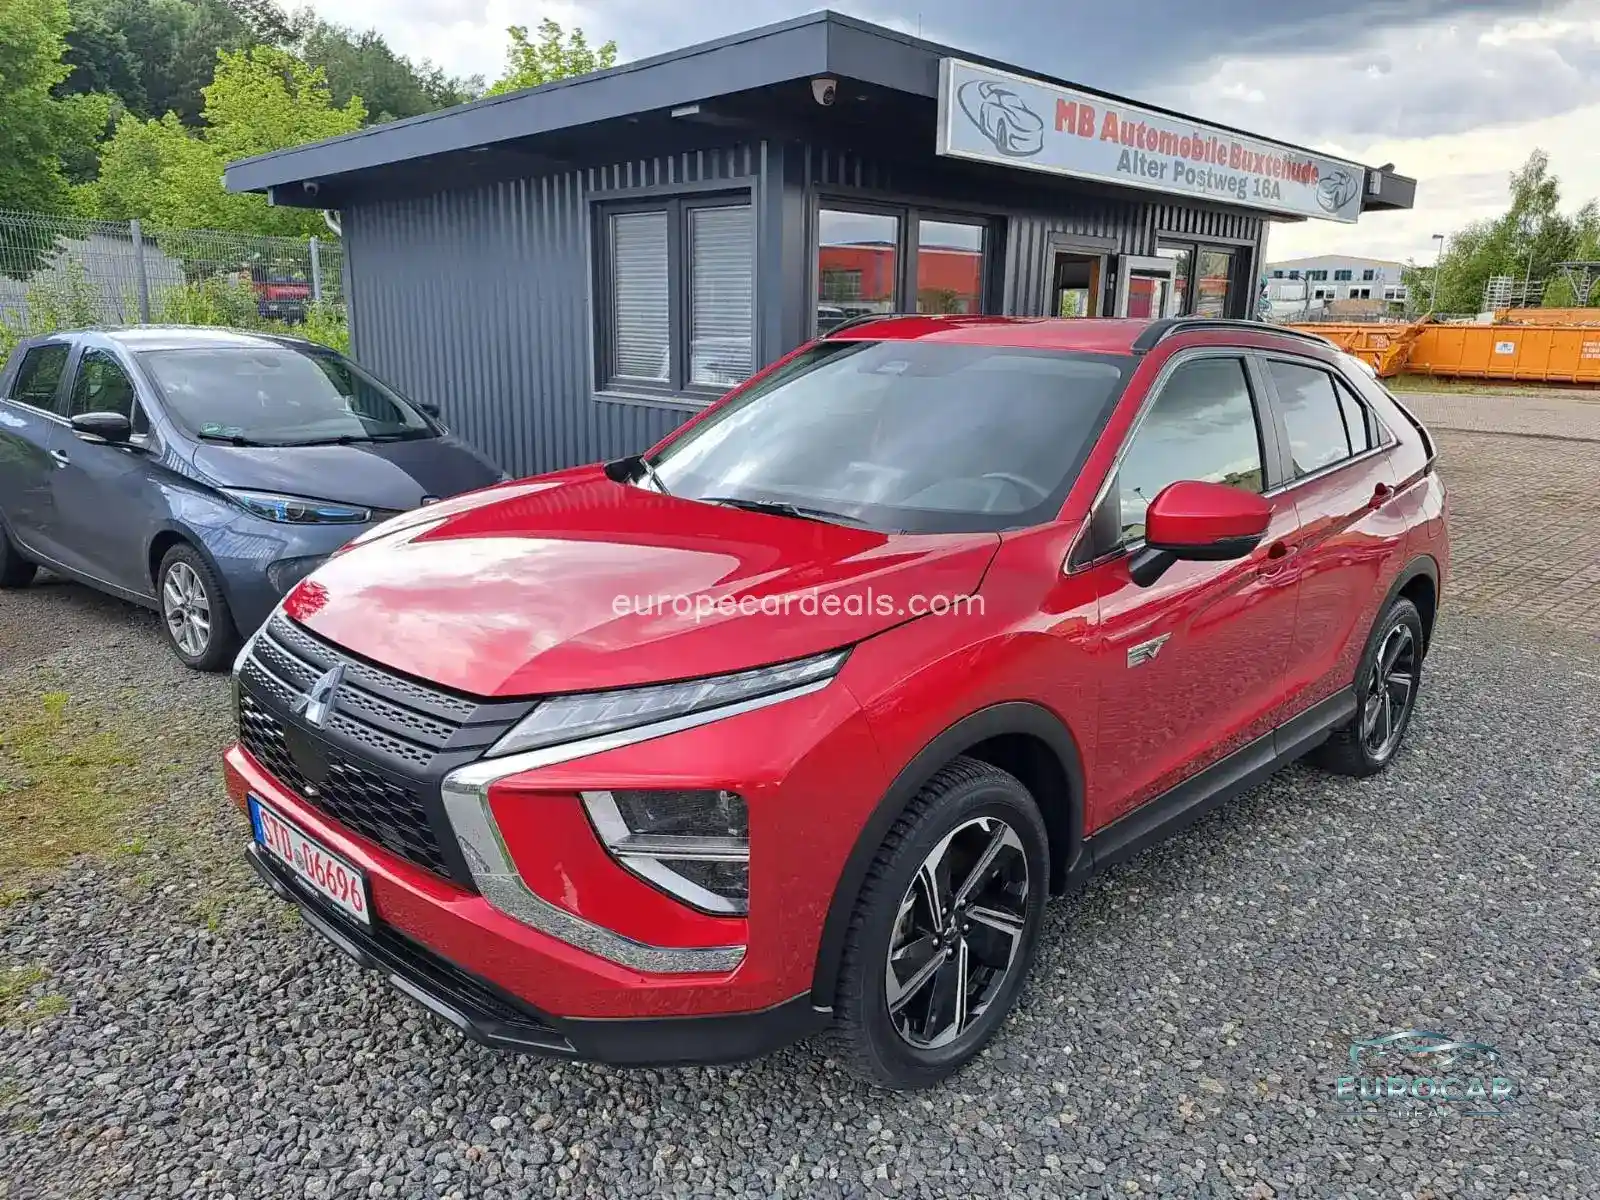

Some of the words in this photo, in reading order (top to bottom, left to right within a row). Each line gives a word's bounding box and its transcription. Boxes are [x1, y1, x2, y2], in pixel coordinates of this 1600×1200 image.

[1055, 98, 1096, 138] MB
[1100, 110, 1228, 166] Automobile
[1116, 149, 1168, 179] Alter
[1173, 160, 1249, 200] Postweg
[1252, 177, 1282, 200] 16A
[302, 841, 363, 913] 06696
